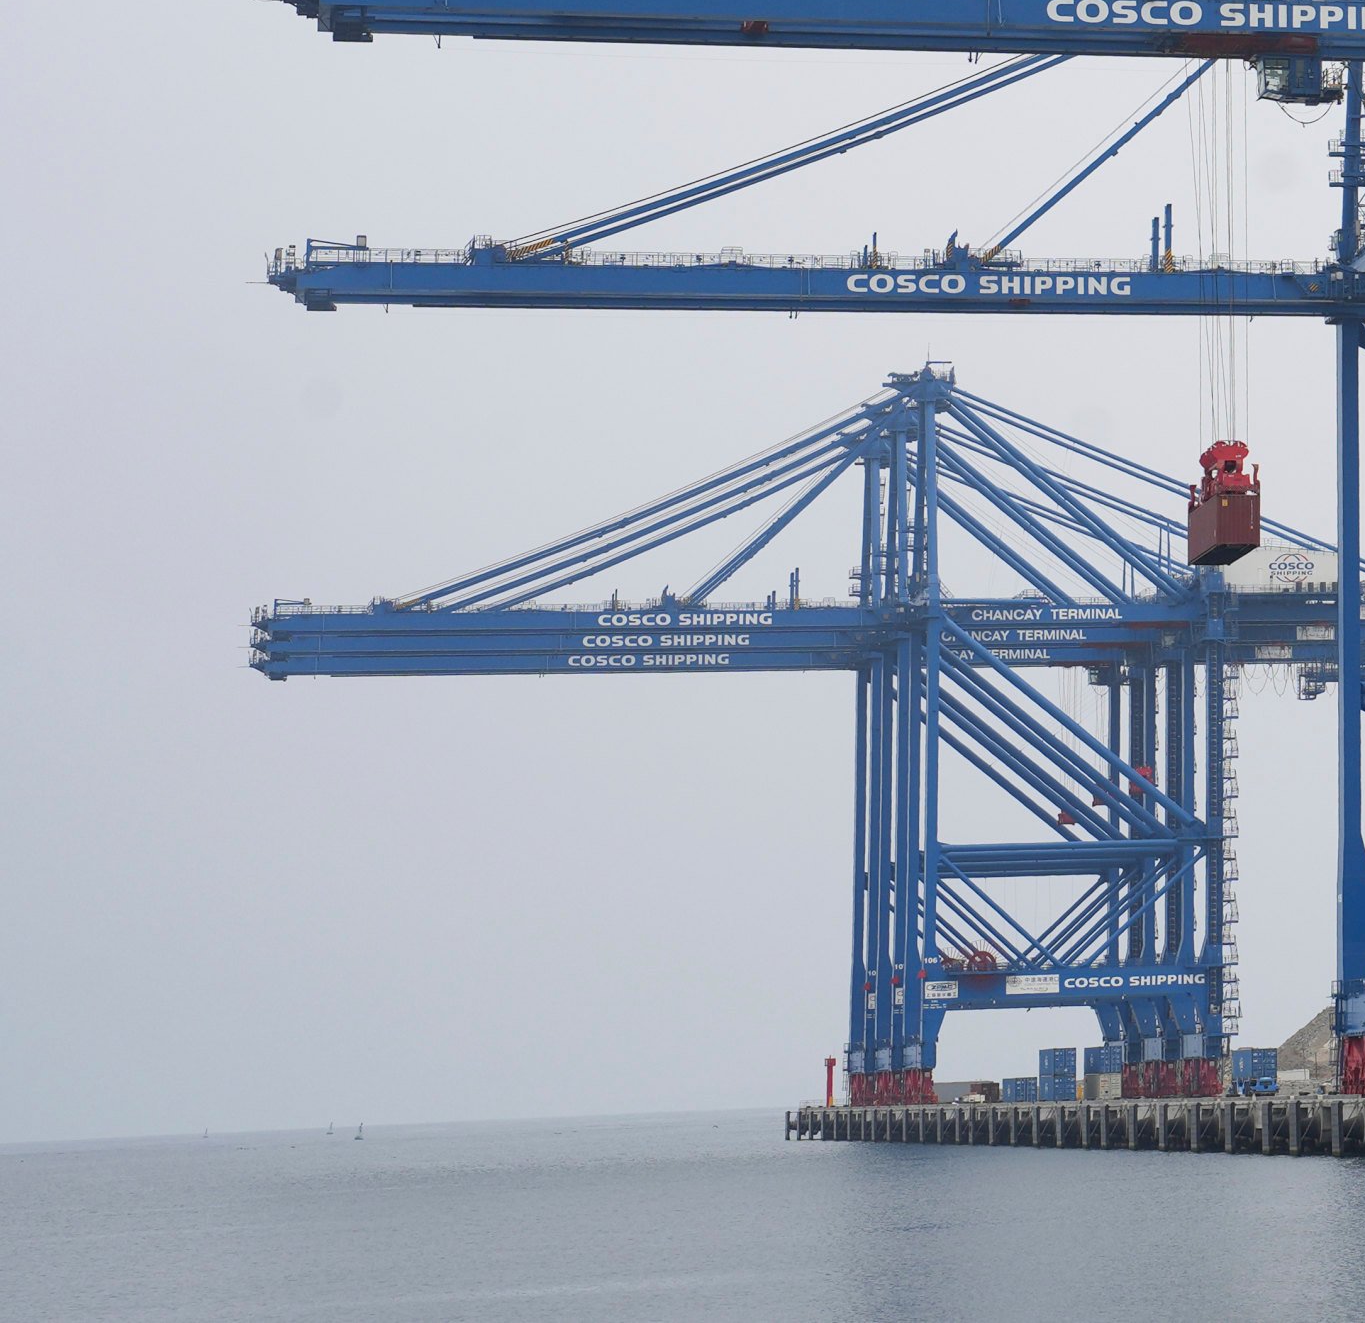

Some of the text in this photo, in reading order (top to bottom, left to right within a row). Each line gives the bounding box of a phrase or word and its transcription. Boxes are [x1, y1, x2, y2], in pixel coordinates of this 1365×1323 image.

[847, 274, 1131, 295] COSCO SHIPPING
[1268, 562, 1315, 571] COSCO
[597, 613, 772, 626] COSCO SHIPPING
[971, 608, 1122, 621] CHANCAY TERMINAL
[582, 634, 750, 647] COSCO SHIPPING
[1017, 629, 1087, 641] TERMINAL
[568, 654, 730, 666] COSCO SHIPPING
[990, 648, 1050, 659] ERMINAL
[1064, 974, 1205, 988] COSCO SHIPPING
